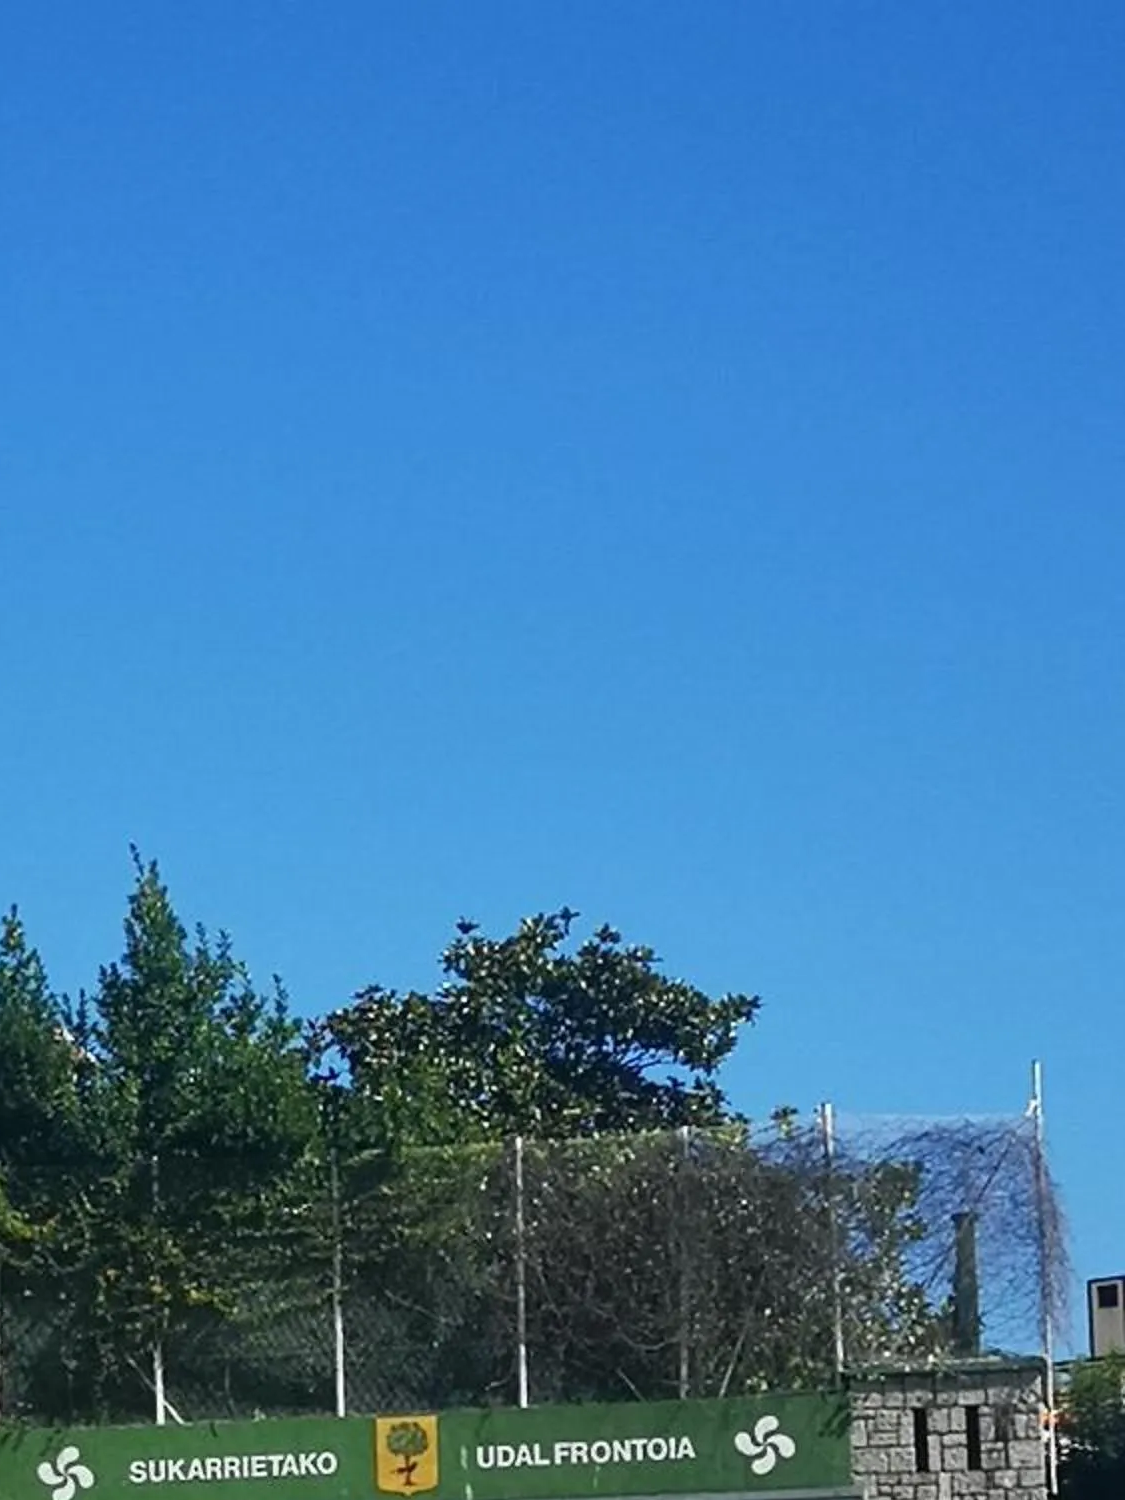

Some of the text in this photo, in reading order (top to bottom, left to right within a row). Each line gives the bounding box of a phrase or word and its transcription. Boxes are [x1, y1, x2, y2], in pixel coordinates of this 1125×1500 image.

[129, 1436, 696, 1483] SUKARRIETAKO UDAL FRONTOIA
